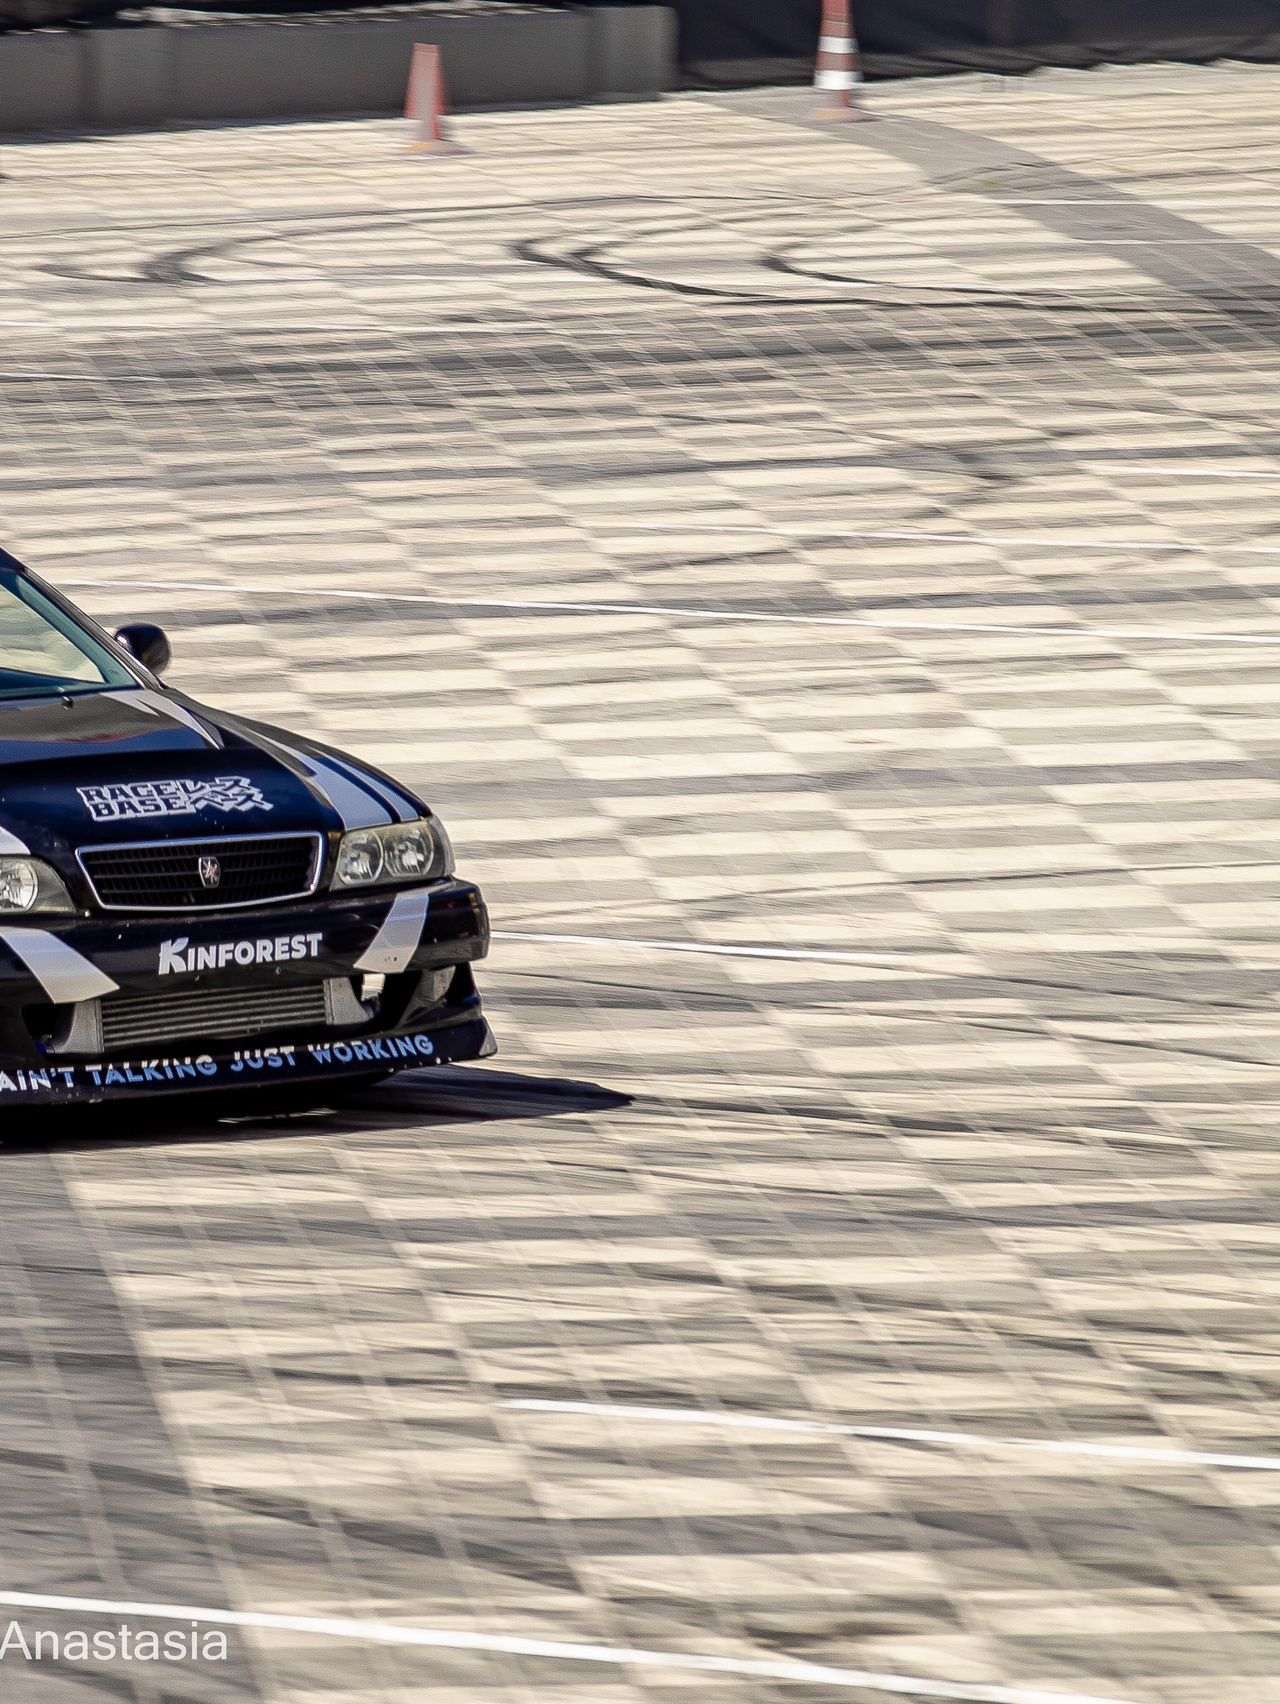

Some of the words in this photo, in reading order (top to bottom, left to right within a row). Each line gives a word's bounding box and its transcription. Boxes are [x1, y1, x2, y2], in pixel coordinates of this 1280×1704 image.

[77, 780, 181, 803] RACE
[88, 797, 196, 822] BASE
[158, 933, 323, 976] KINFOREST
[85, 1054, 217, 1086] TALKING
[230, 1045, 295, 1073] JUST
[308, 1034, 435, 1063] WORKING
